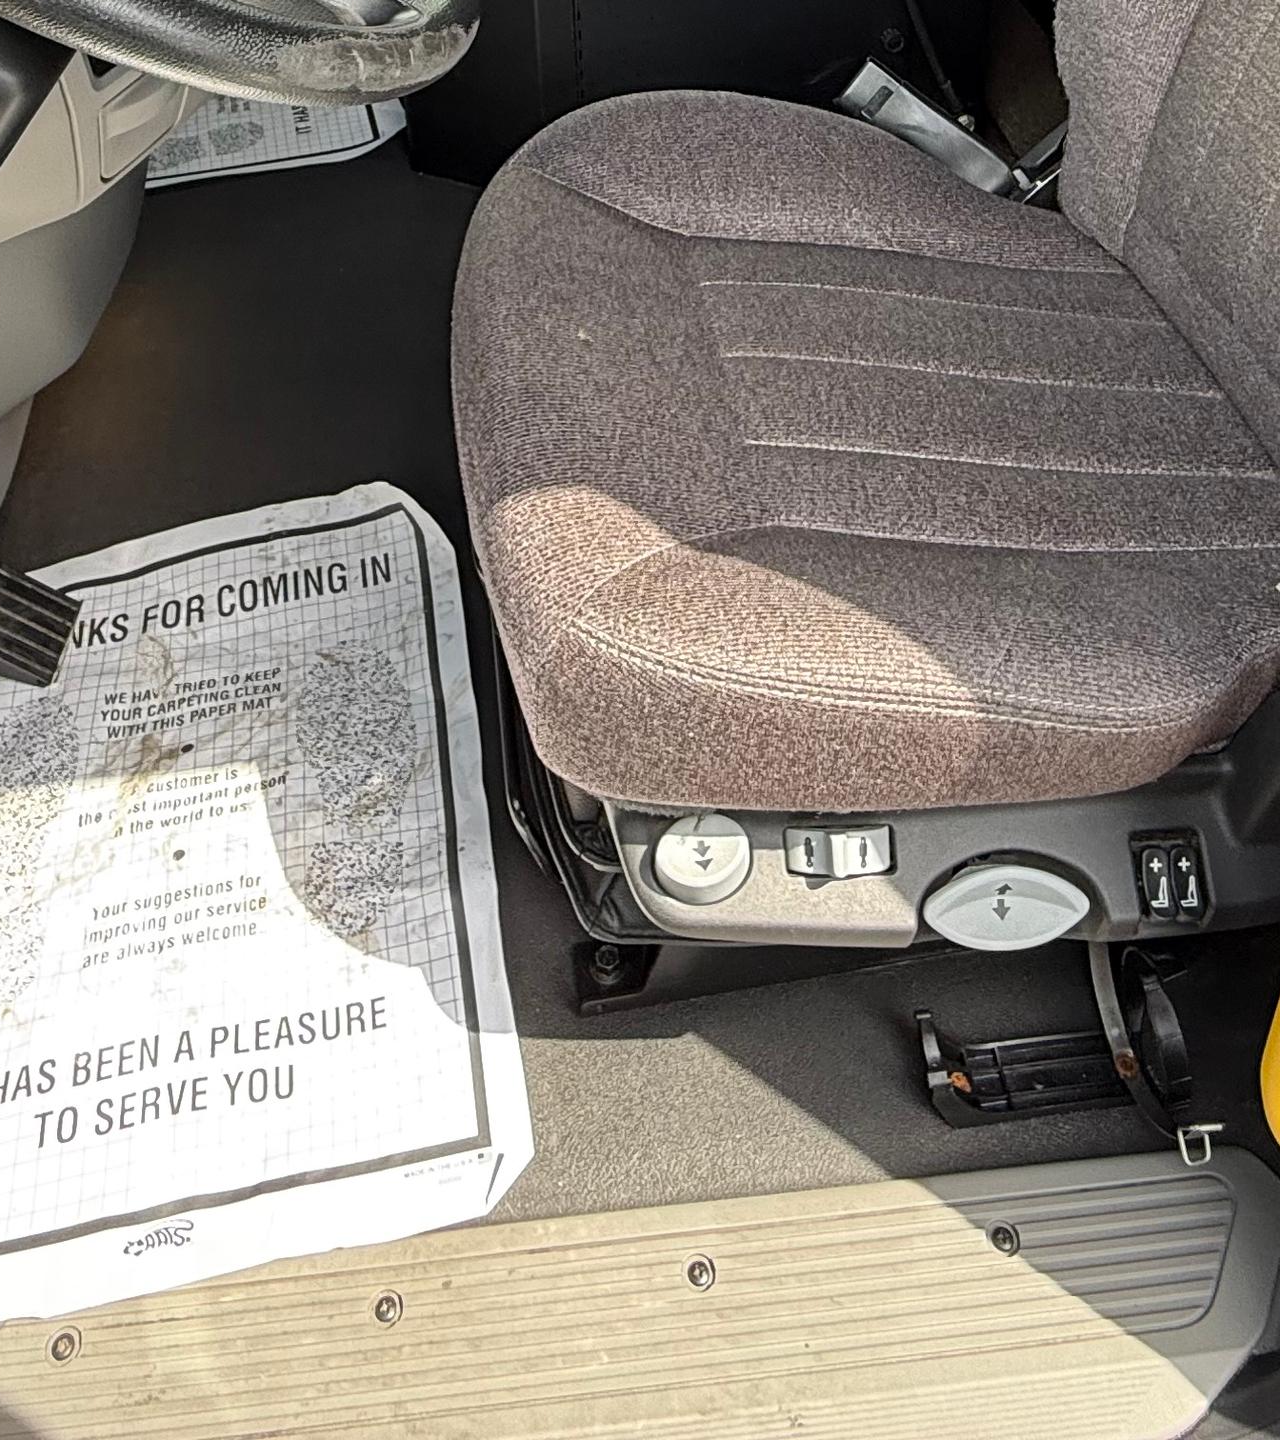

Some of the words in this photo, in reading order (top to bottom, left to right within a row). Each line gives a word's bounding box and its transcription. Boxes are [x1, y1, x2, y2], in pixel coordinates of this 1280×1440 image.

[295, 125, 312, 136] IT
[140, 593, 205, 634] FOR
[216, 561, 347, 617] COMING
[359, 552, 391, 588] IN
[99, 705, 142, 722] YOUR
[146, 689, 230, 717] CARPETING
[233, 681, 282, 698] CLEAN
[103, 691, 127, 705] WE
[173, 677, 217, 695] TRIED
[222, 673, 240, 686] TO
[243, 666, 281, 683] KEEP
[106, 721, 148, 739] WITH
[151, 713, 185, 731] THIS
[189, 701, 237, 723] PAPER
[241, 694, 275, 711] MAT
[145, 772, 219, 793] customer
[224, 767, 238, 780] is
[77, 811, 103, 828] the
[152, 786, 229, 811] important
[129, 818, 154, 834] the
[159, 807, 203, 828] world
[208, 805, 224, 817] to
[90, 900, 130, 921] Your
[133, 879, 233, 911] suggestions
[239, 874, 261, 888] for
[173, 907, 200, 925] our
[205, 895, 267, 917] service
[81, 950, 109, 969] are
[115, 935, 175, 960] always
[71, 1033, 159, 1087] BEEN
[173, 1029, 194, 1063] A
[209, 995, 387, 1058] PLEASURE
[33, 1105, 78, 1148] TO
[93, 1075, 208, 1136] SERVE
[222, 1063, 294, 1106] YOU
